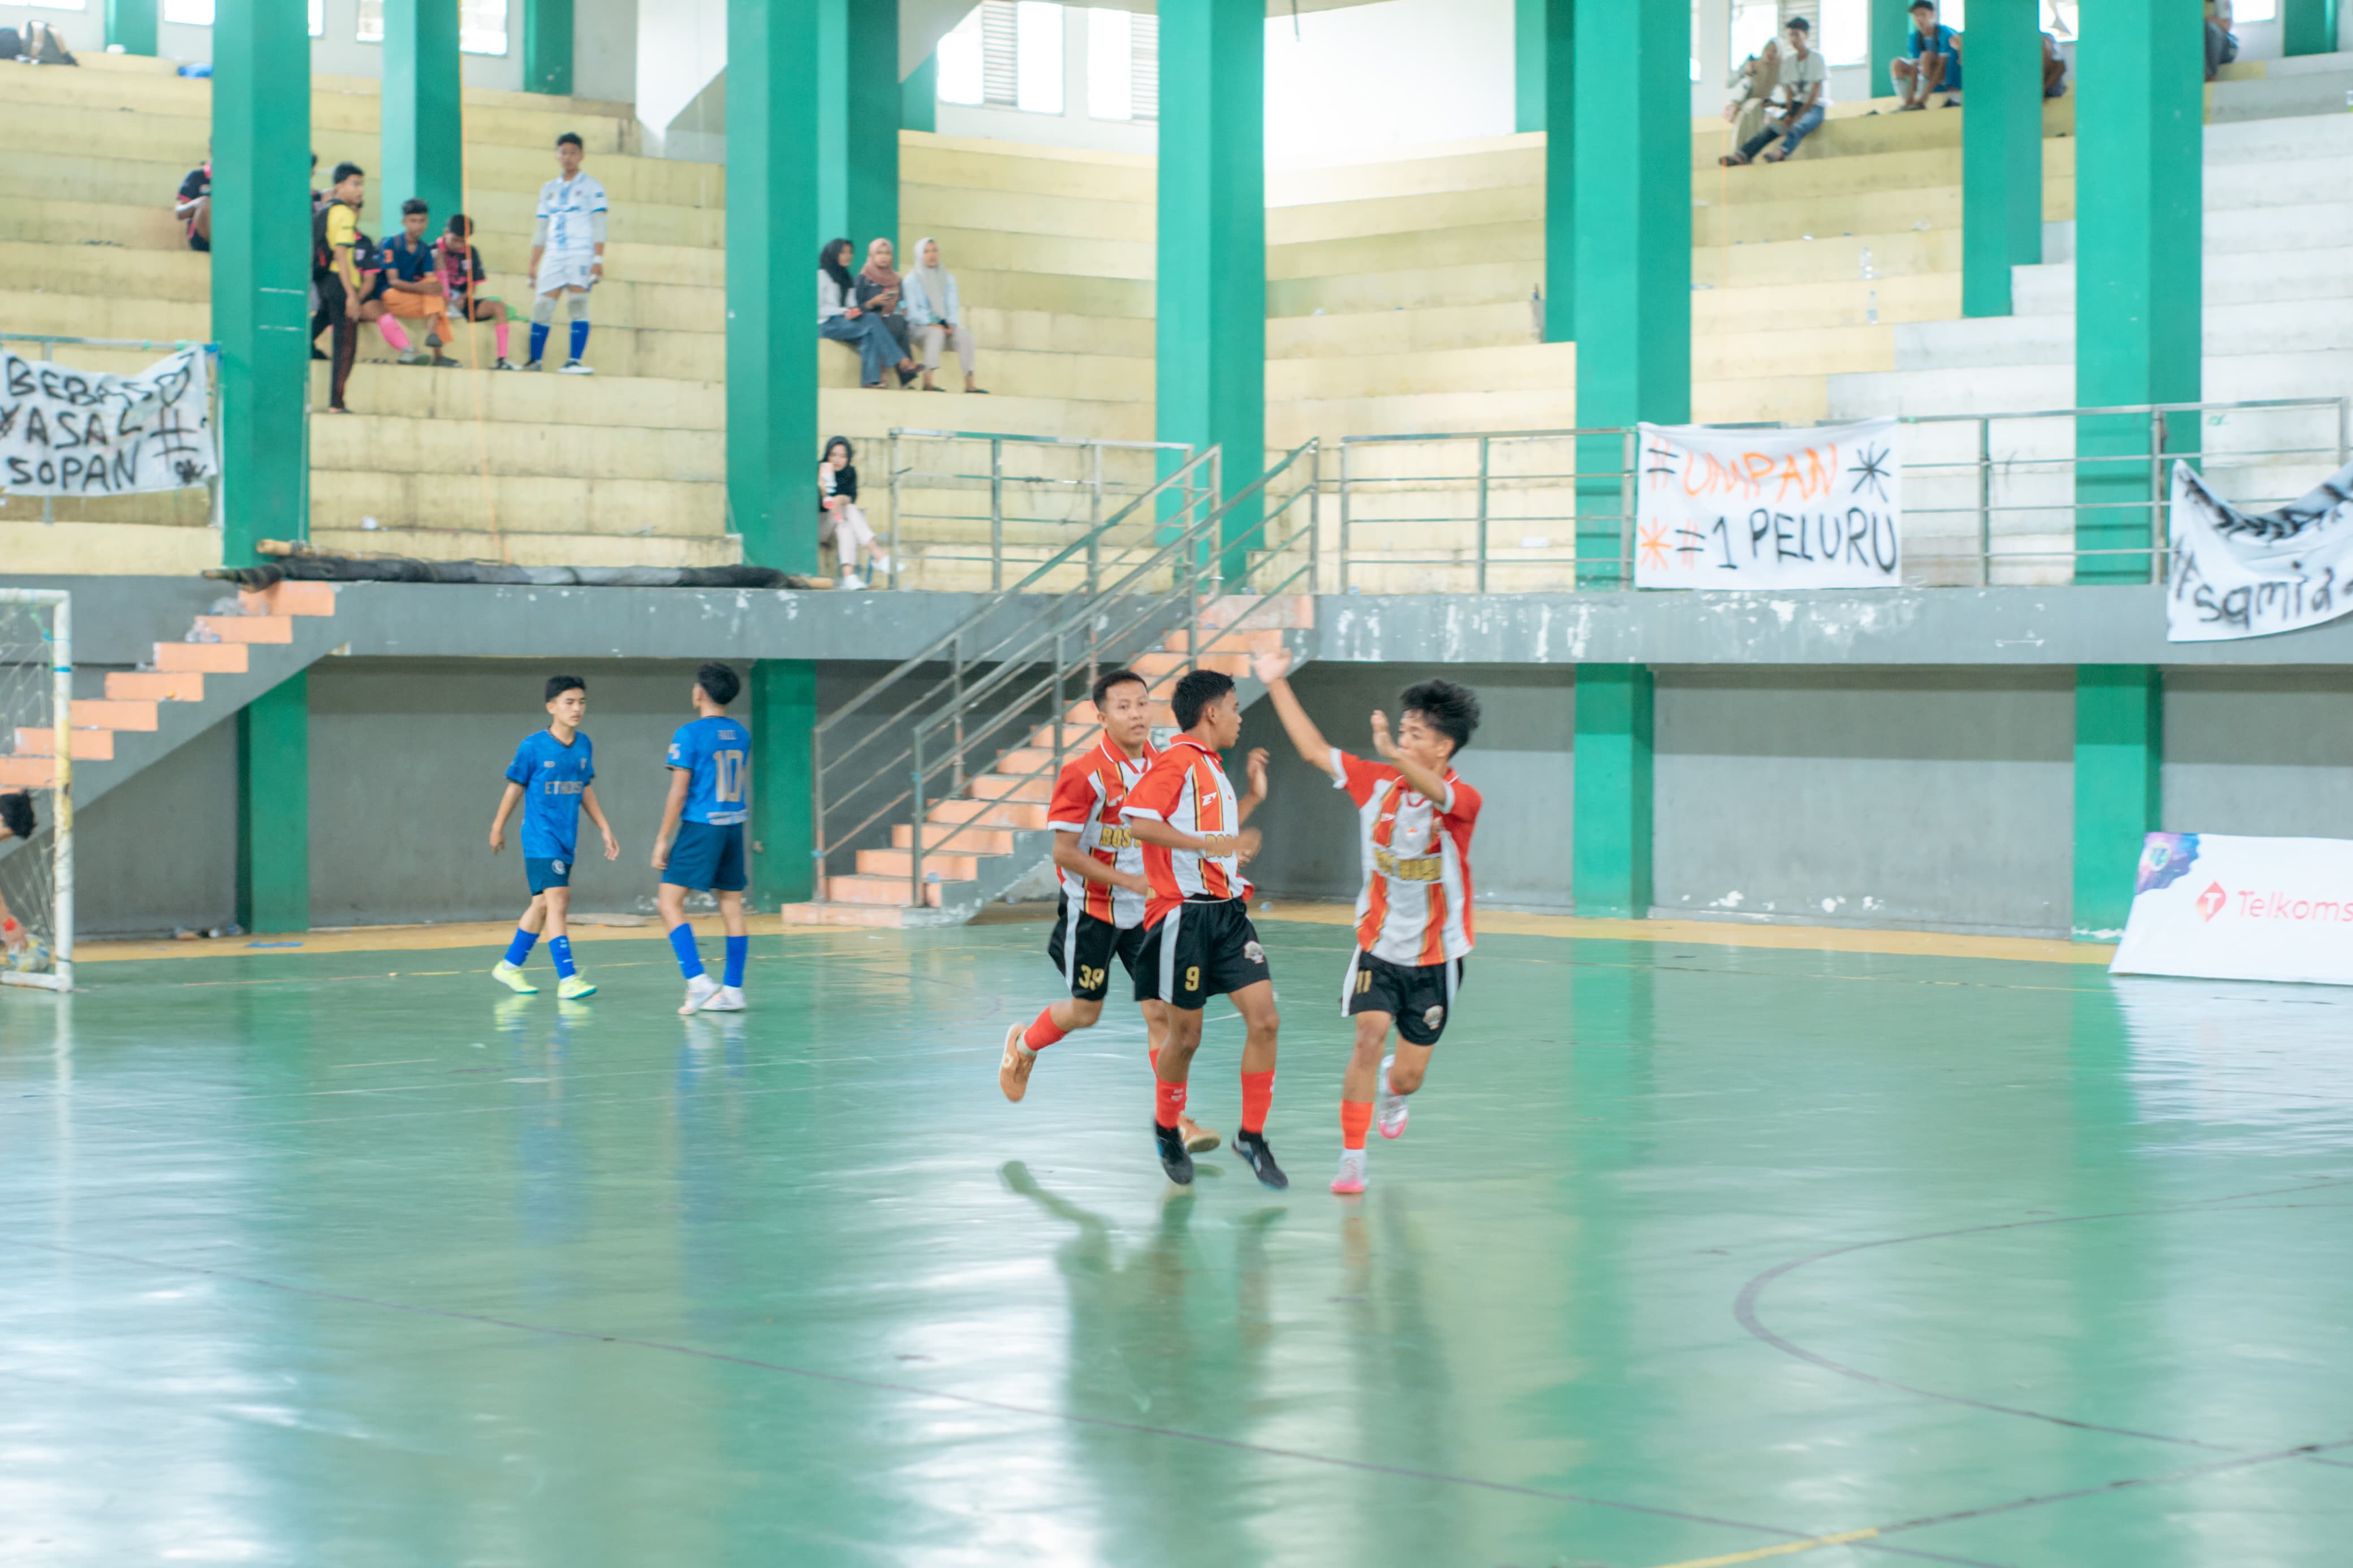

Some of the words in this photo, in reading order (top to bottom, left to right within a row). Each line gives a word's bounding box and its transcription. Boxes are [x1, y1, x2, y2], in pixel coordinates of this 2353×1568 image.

[7, 440, 140, 491] SOPAN
[1750, 507, 1897, 572] PELURU
[713, 750, 744, 802] 10
[2238, 890, 2353, 922] Telkoms
[1078, 964, 1105, 991] 39
[1184, 965, 1200, 992] 9
[1356, 970, 1372, 994] 11
